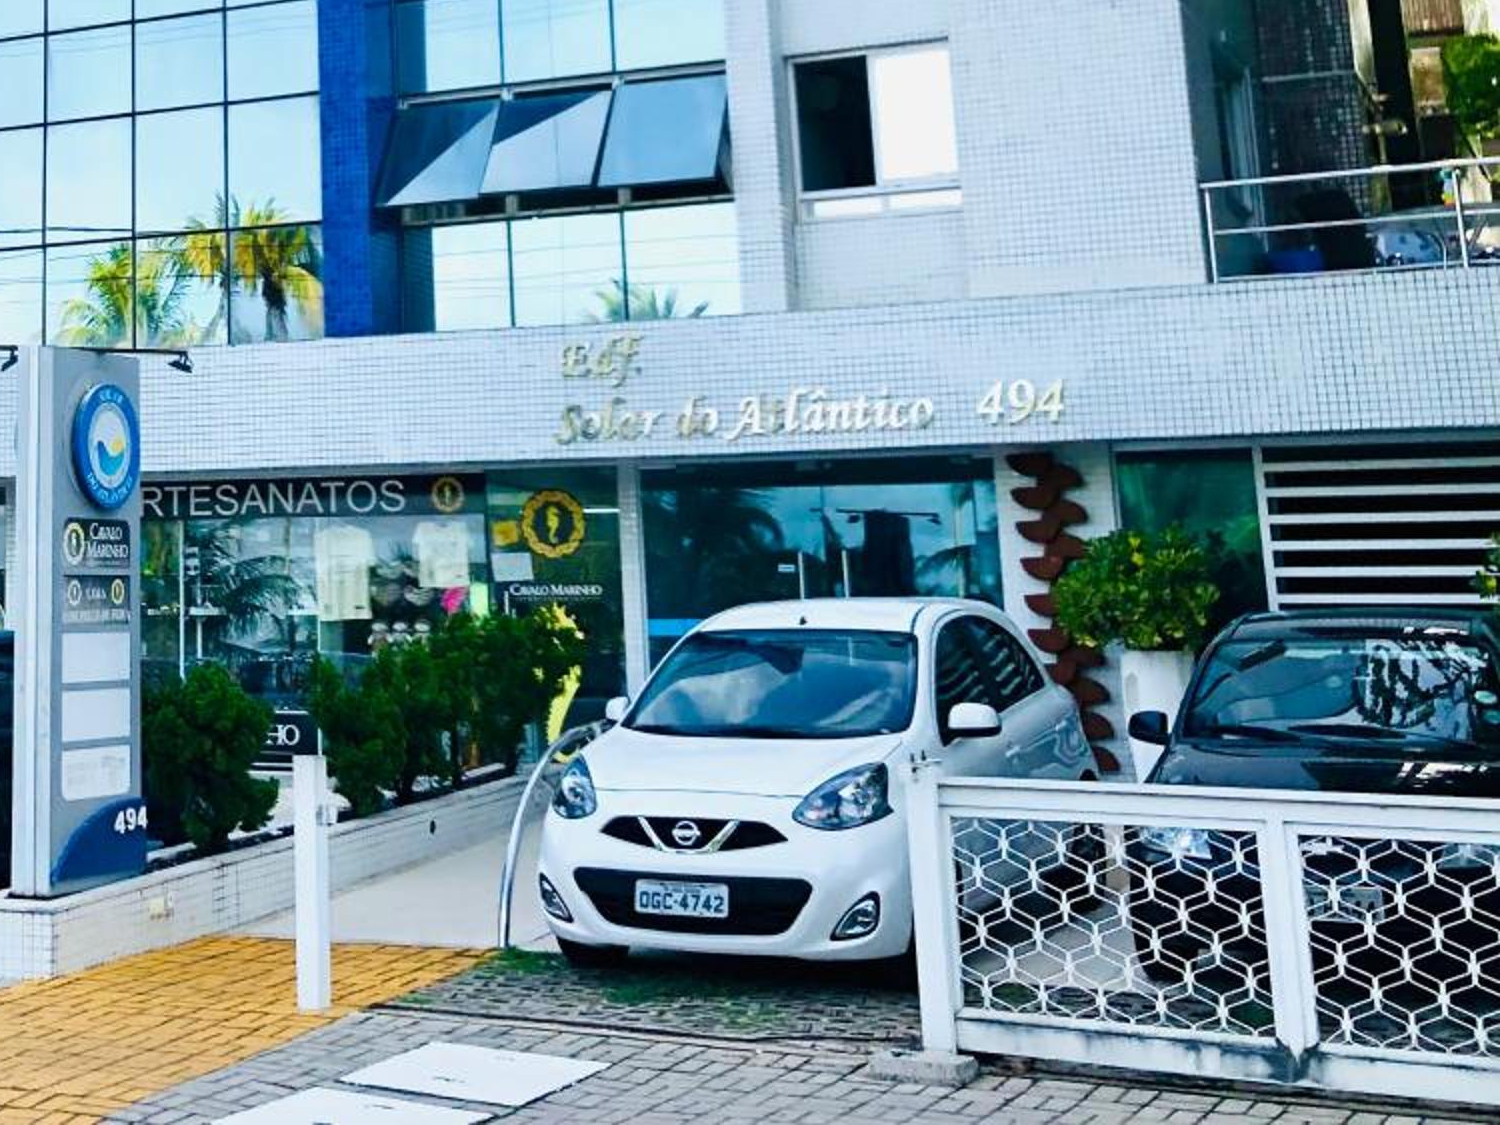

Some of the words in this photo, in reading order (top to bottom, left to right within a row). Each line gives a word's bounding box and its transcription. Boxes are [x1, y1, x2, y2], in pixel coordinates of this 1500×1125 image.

[676, 395, 720, 439] do
[726, 383, 934, 442] Atlântico
[977, 378, 1065, 426] 494
[113, 805, 149, 835] 494
